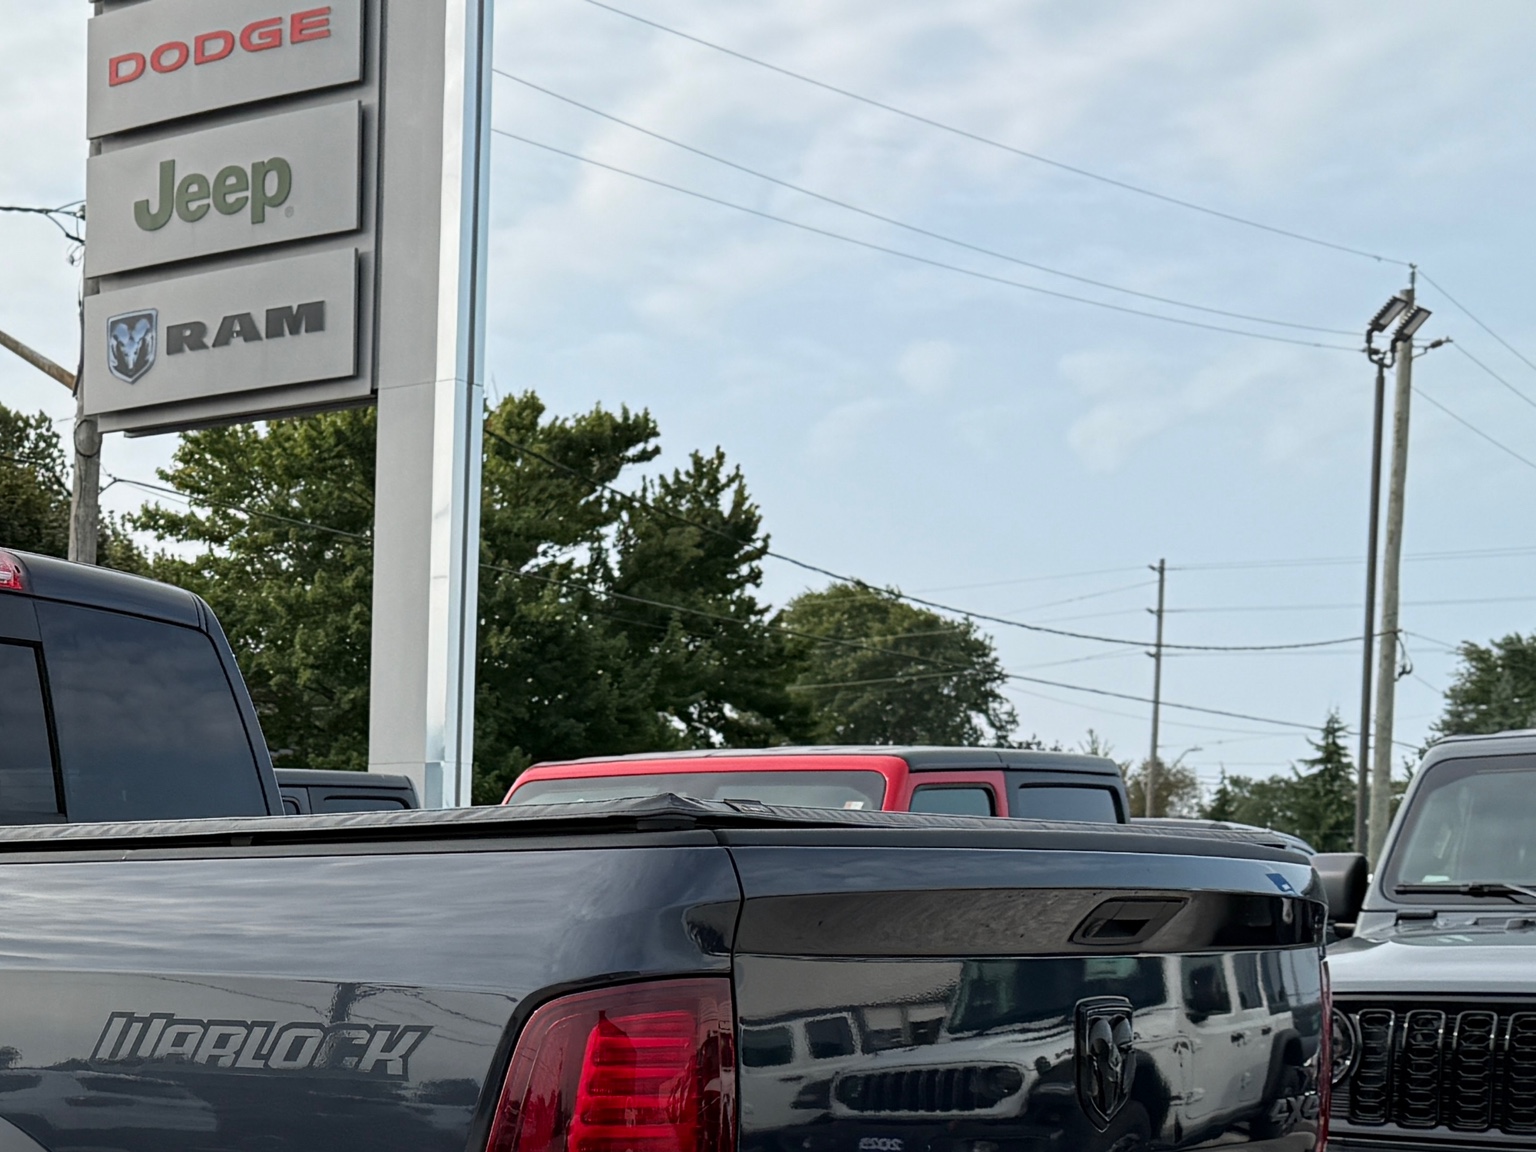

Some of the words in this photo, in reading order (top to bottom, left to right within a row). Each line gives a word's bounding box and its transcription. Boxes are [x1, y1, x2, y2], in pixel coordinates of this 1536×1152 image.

[109, 6, 331, 87] DODGE
[133, 156, 292, 231] Jeep
[166, 301, 325, 355] RAM
